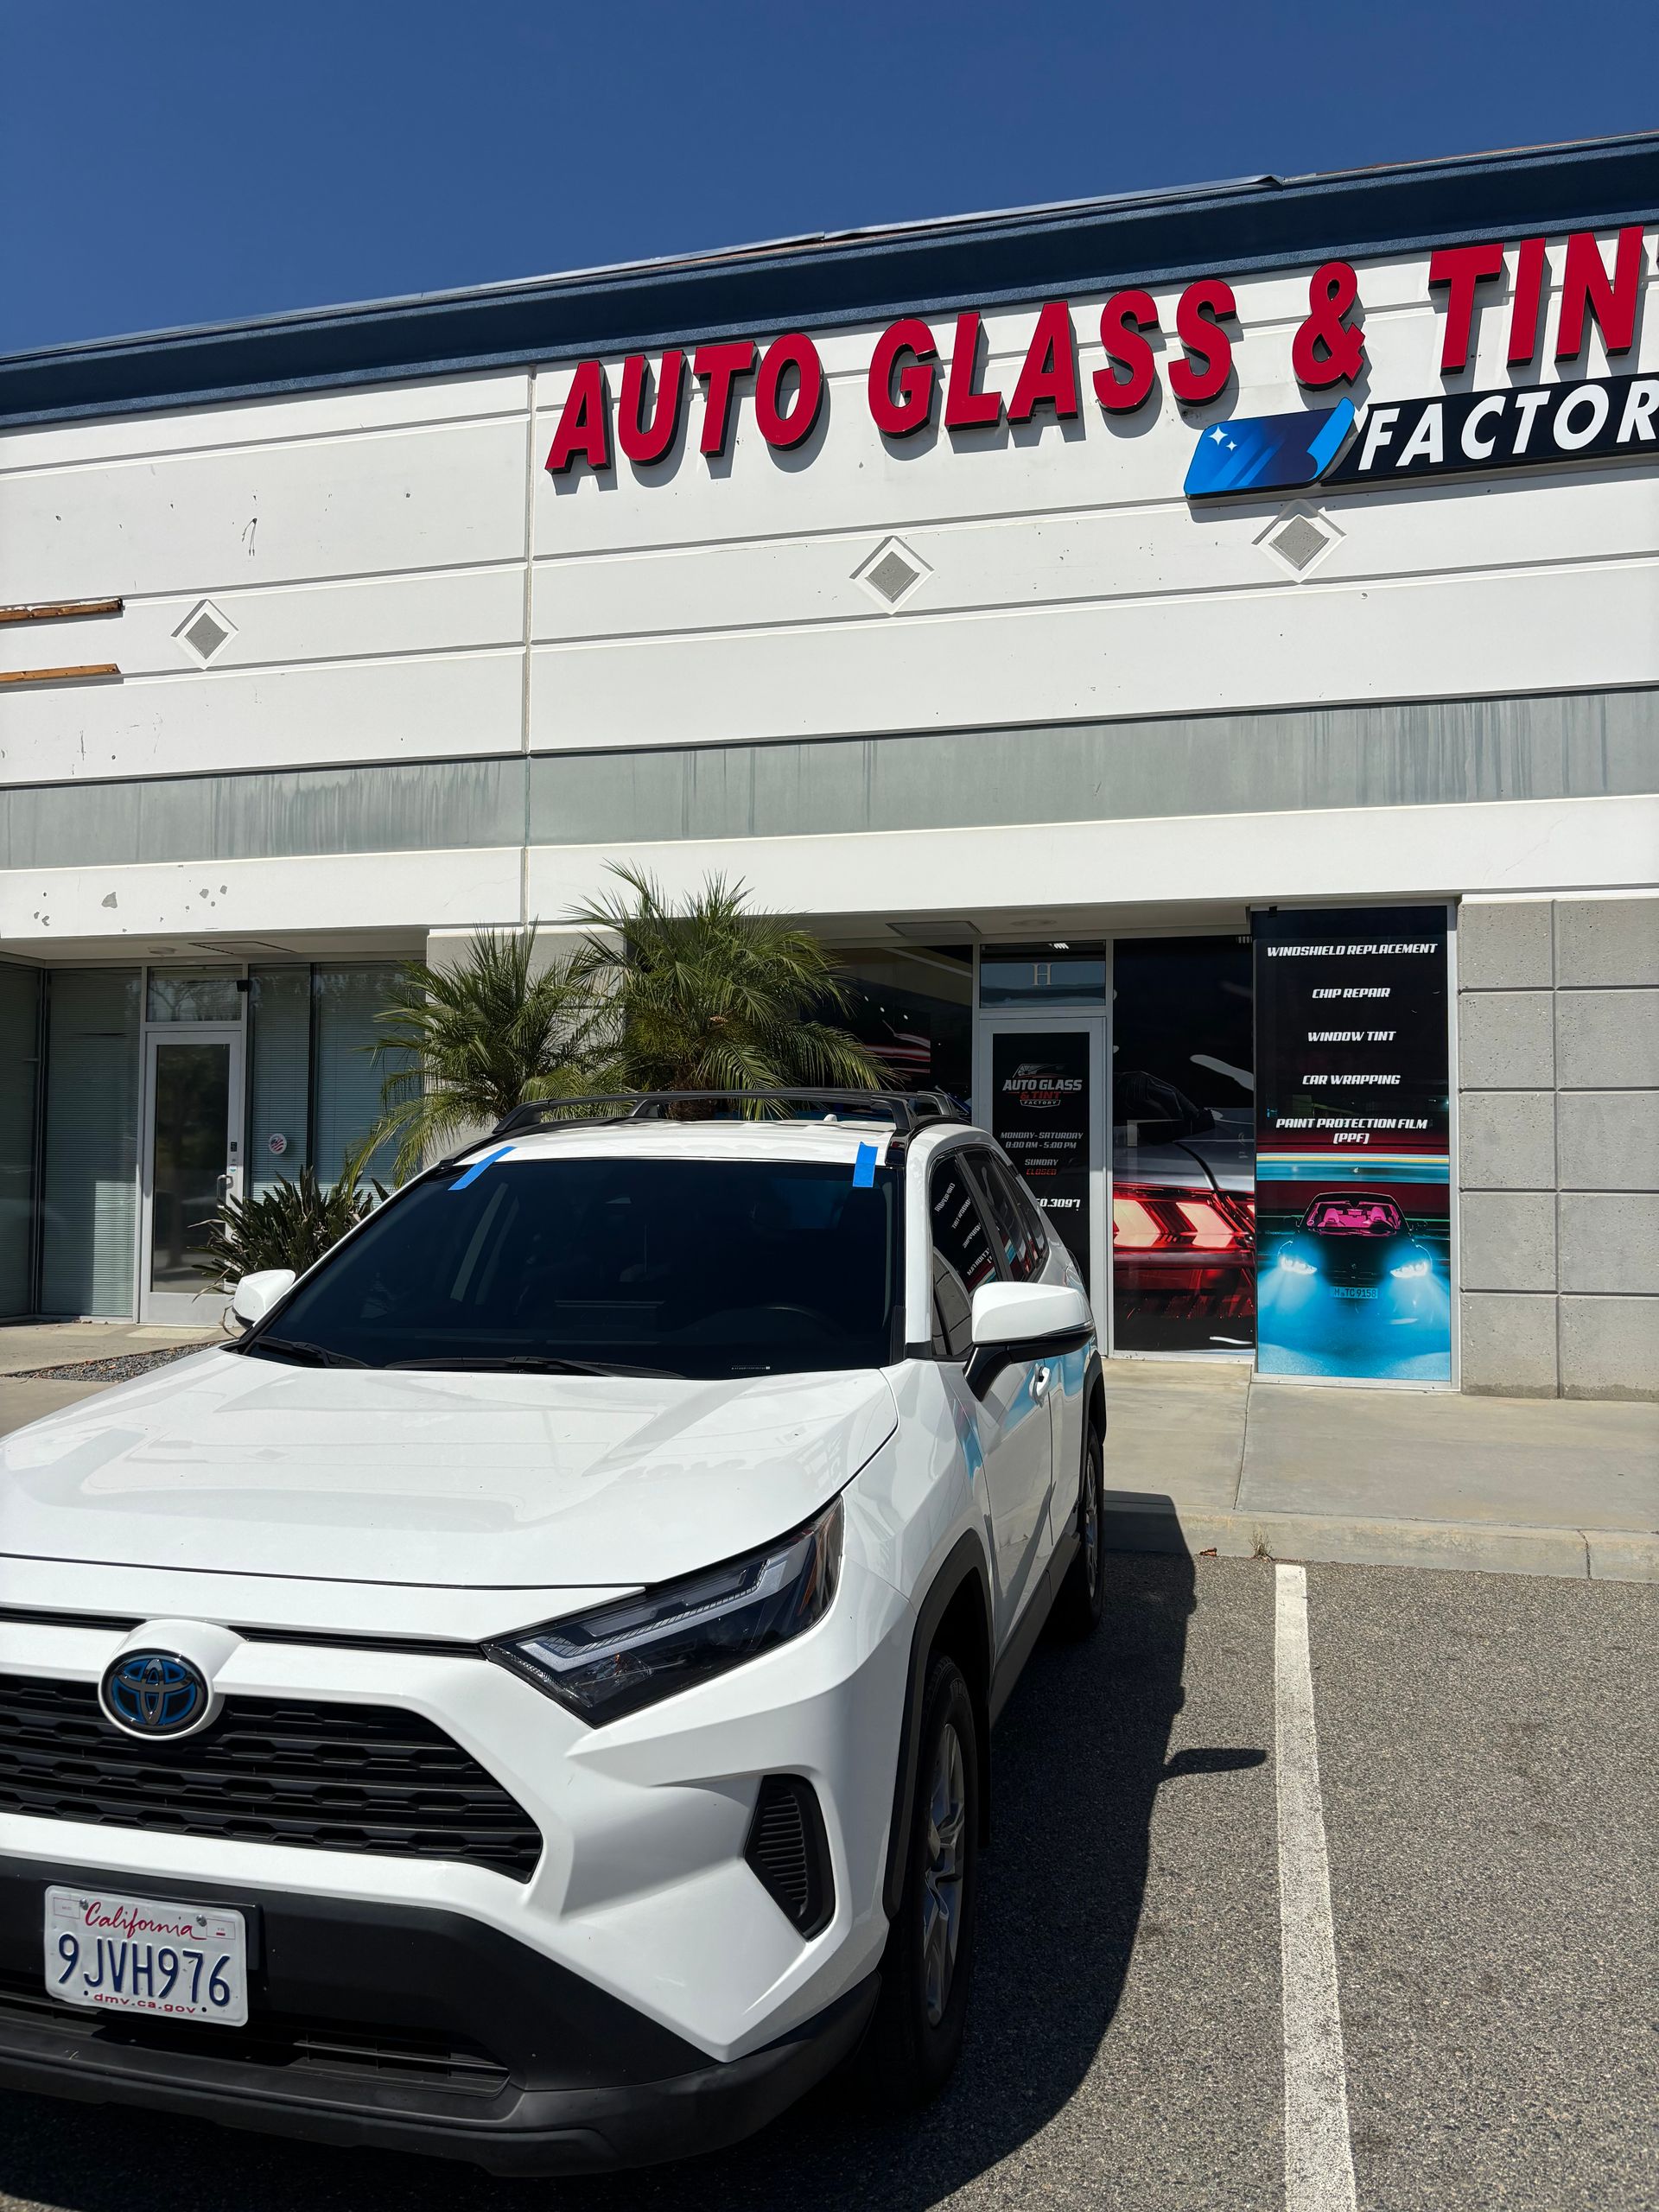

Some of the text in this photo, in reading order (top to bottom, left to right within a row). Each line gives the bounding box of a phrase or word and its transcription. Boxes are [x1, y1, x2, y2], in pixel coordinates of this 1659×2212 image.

[544, 226, 1659, 474] AUTO GLASS & TIN
[1267, 944, 1438, 957] WINDSHIELD REPLACEMENT
[1032, 963, 1052, 985] H
[1312, 988, 1390, 999] CHIP REPAIR
[1307, 1031, 1396, 1042] WINDOW TINT
[1002, 1079, 1083, 1090] AUTO GLASS
[1302, 1075, 1401, 1085] CAR WRAPPING
[1032, 1091, 1061, 1100] TINT
[1275, 1118, 1428, 1129] PAINT PROTECTION FILM
[1357, 1289, 1376, 1298] 9158
[85, 1901, 207, 1940] California
[58, 1933, 231, 2006] 9JVH976
[93, 1993, 196, 2014] dmv.ca.gov
